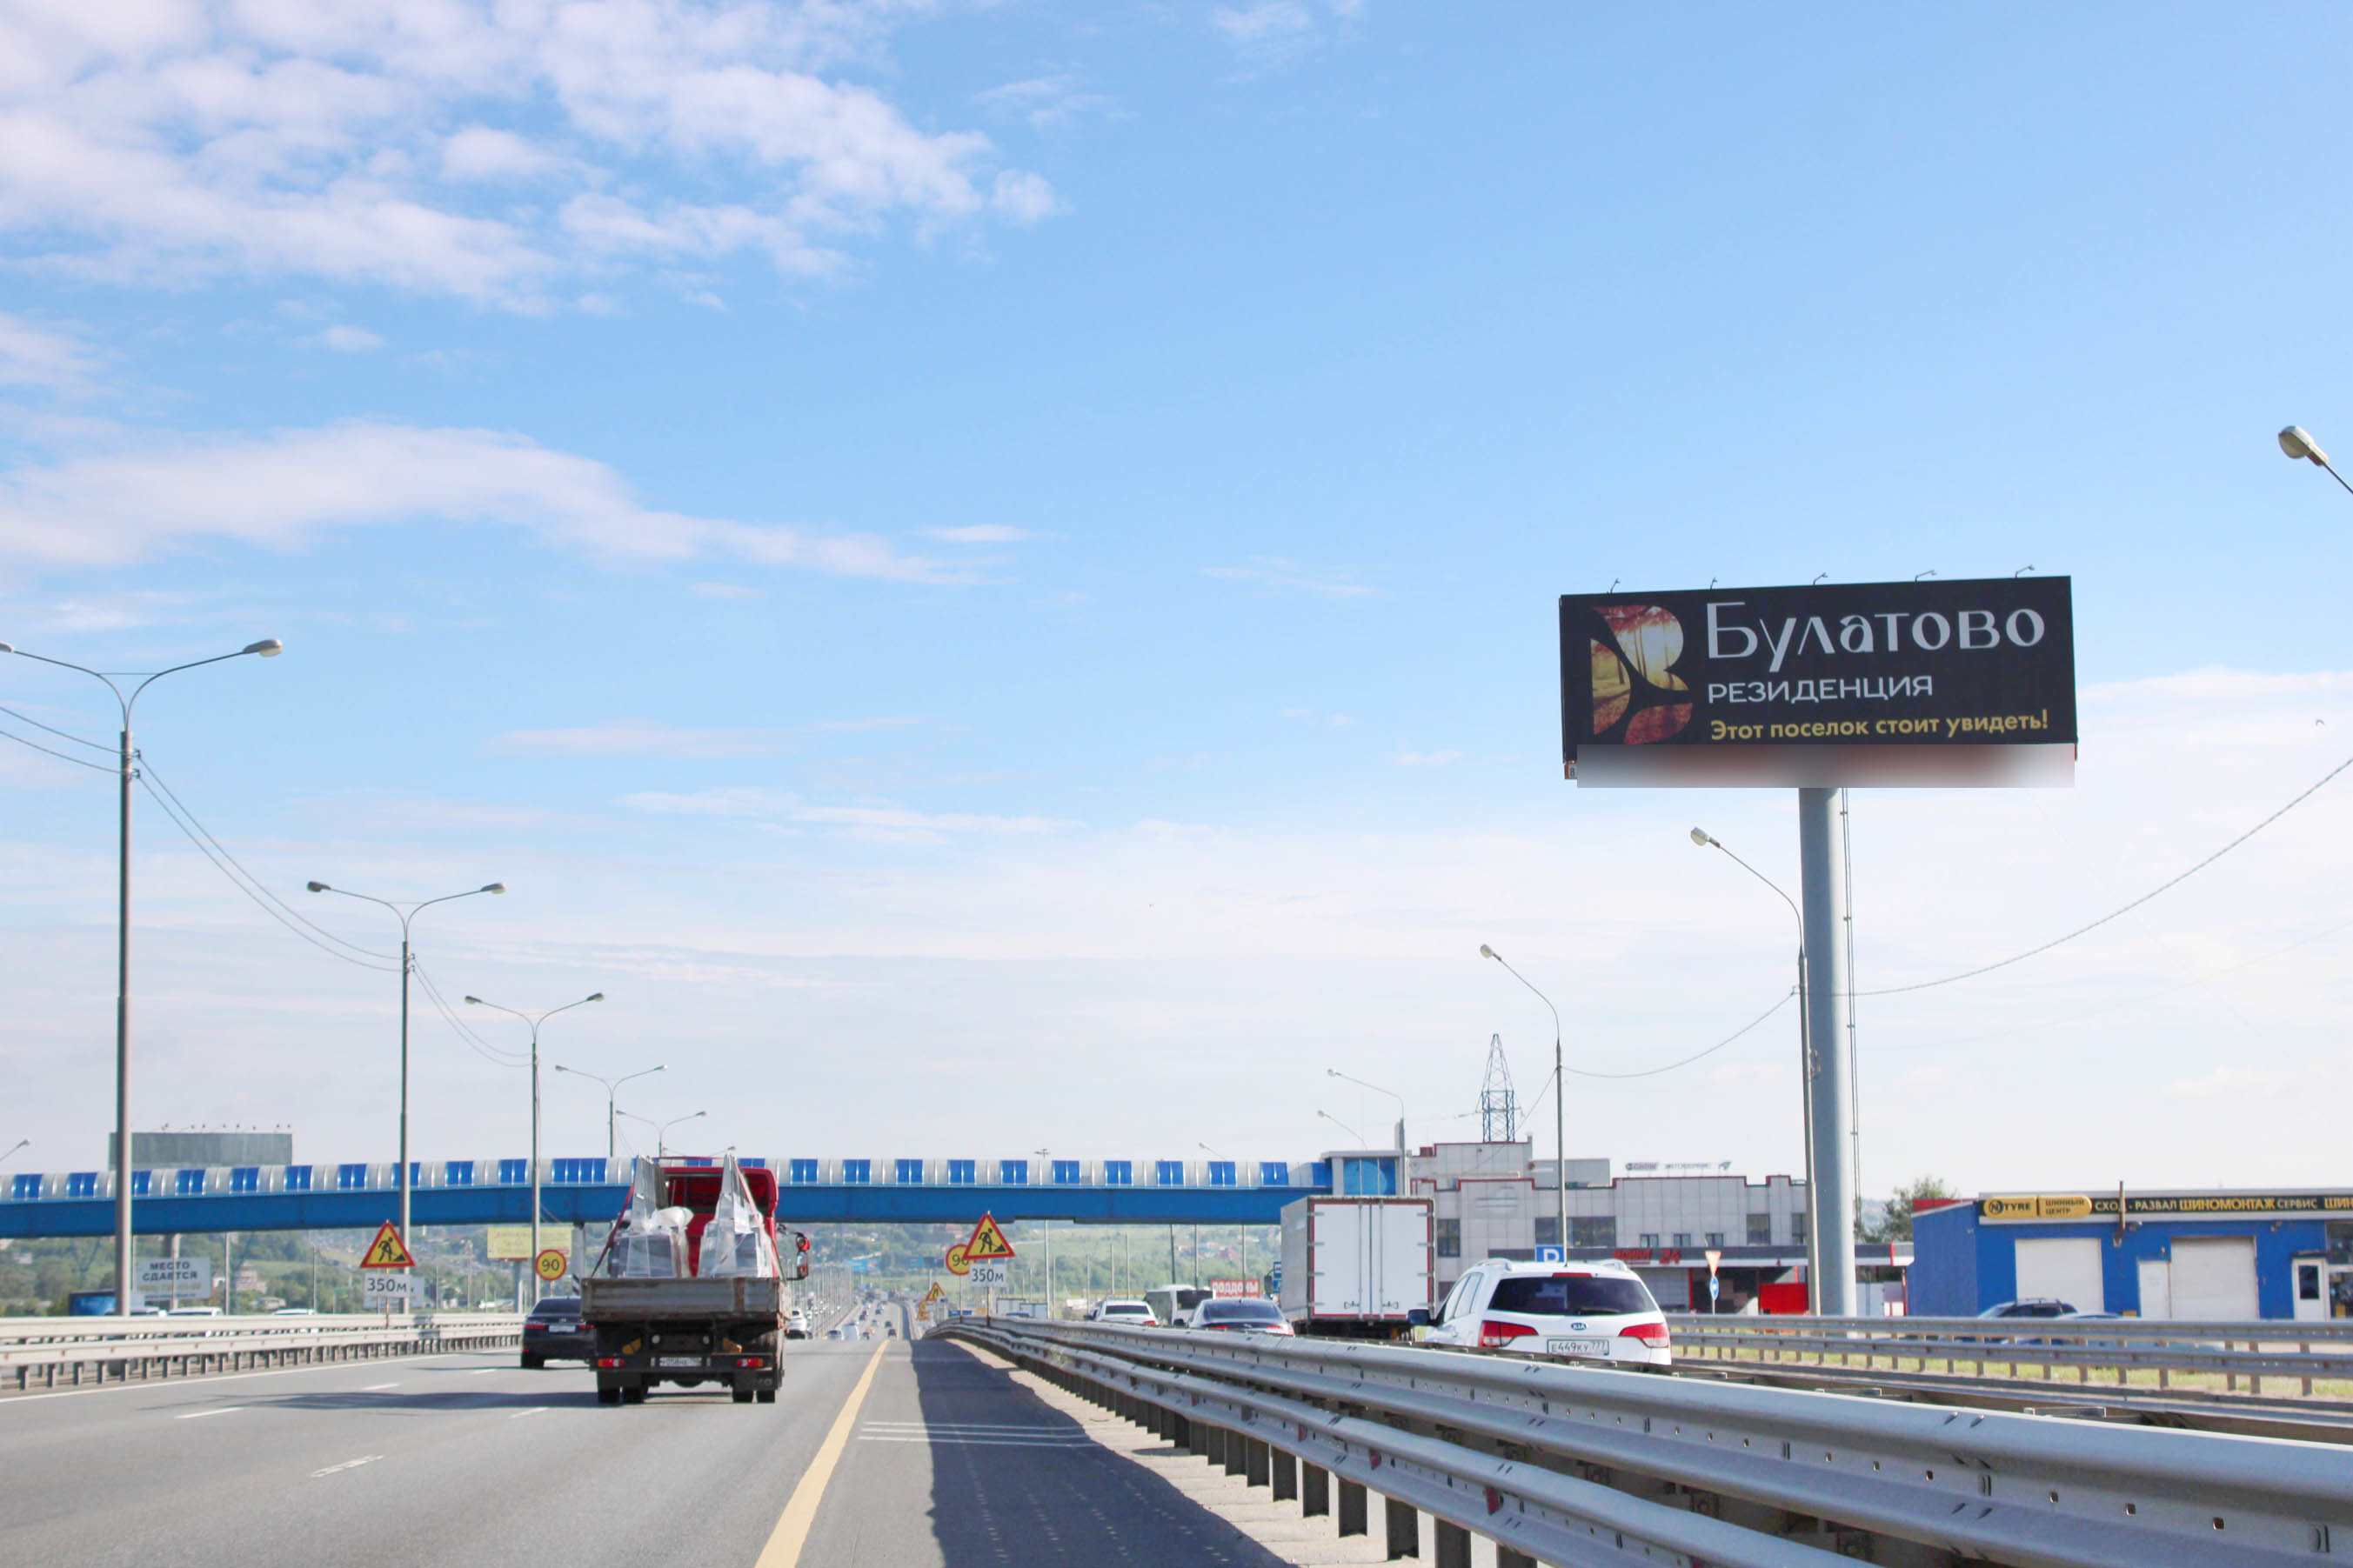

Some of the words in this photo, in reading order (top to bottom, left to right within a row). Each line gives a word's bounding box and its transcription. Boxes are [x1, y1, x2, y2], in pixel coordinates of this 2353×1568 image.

[1707, 602, 2045, 673] Булатово
[1708, 676, 1933, 704] РЕЗИДЕНЦИЯ
[1711, 720, 1763, 740] Этот
[1770, 720, 1868, 739] поселок
[1875, 717, 1940, 735] стоит
[1948, 709, 2049, 737] увидеть!
[2136, 1199, 2176, 1211] РАЗВАЛ
[2180, 1198, 2276, 1211] ШИНОМОНТАЖ
[2277, 1199, 2317, 1209] СЕРВИС
[150, 1261, 190, 1270] МЕСТО
[542, 1258, 559, 1271] 90
[142, 1271, 197, 1281] СДАЕТСЯ
[972, 1269, 1004, 1282] 350м
[367, 1278, 406, 1292] 350м
